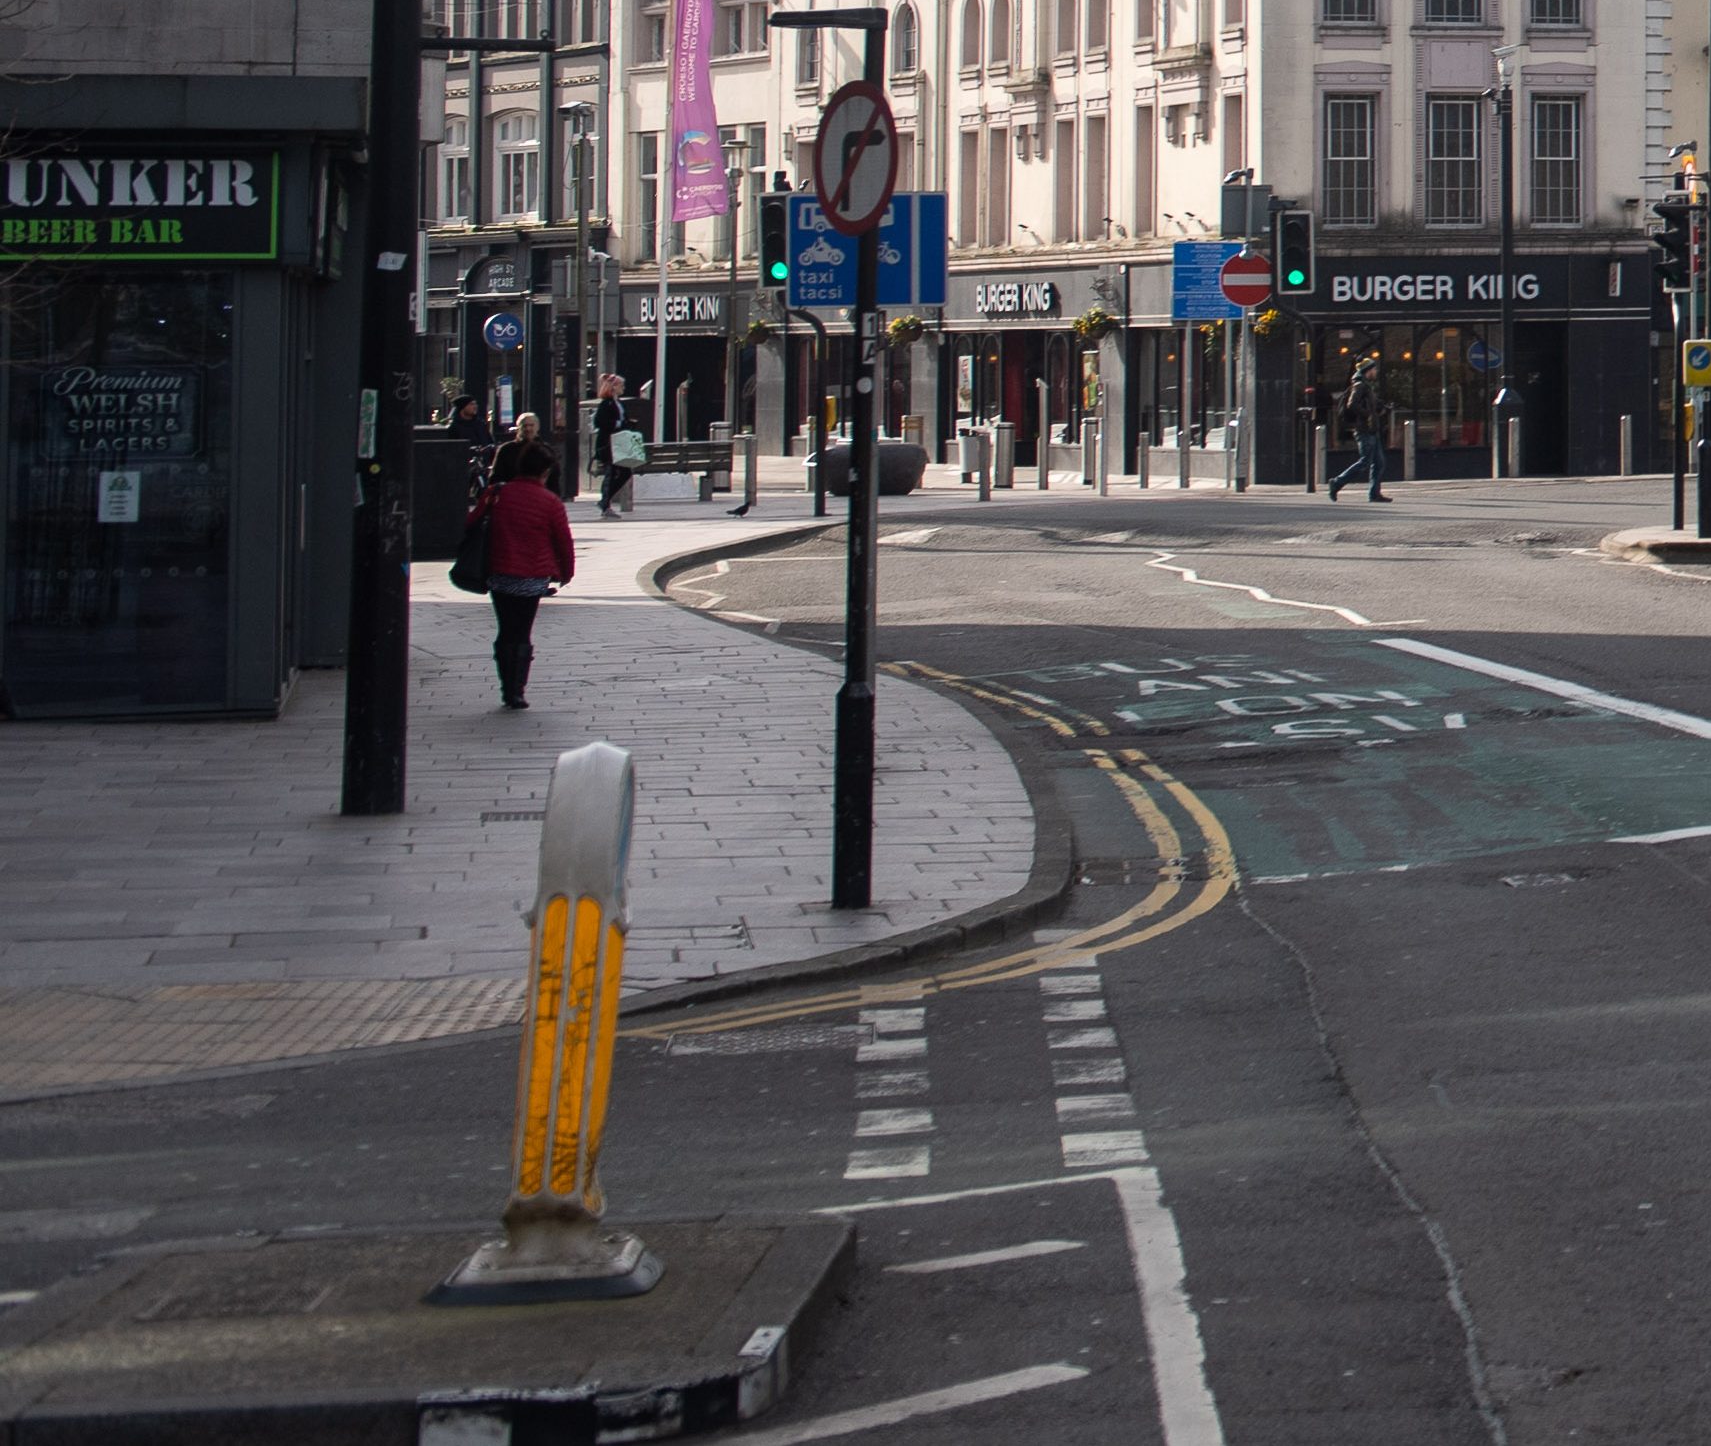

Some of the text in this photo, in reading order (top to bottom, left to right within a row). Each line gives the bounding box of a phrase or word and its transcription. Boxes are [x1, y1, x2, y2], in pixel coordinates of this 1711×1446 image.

[690, 38, 698, 50] TO
[687, 52, 696, 102] WELCOME
[1, 219, 184, 244] BEER BAR
[799, 269, 834, 284] taxi
[799, 285, 843, 300] tacsi
[976, 282, 1051, 312] BURGER KING
[1332, 275, 1454, 302] BURGER
[640, 296, 690, 323] BUGER
[53, 366, 184, 396] Premium
[69, 393, 181, 415] WELSH
[67, 418, 179, 433] SPIRITS &
[79, 437, 169, 452] LAGERS
